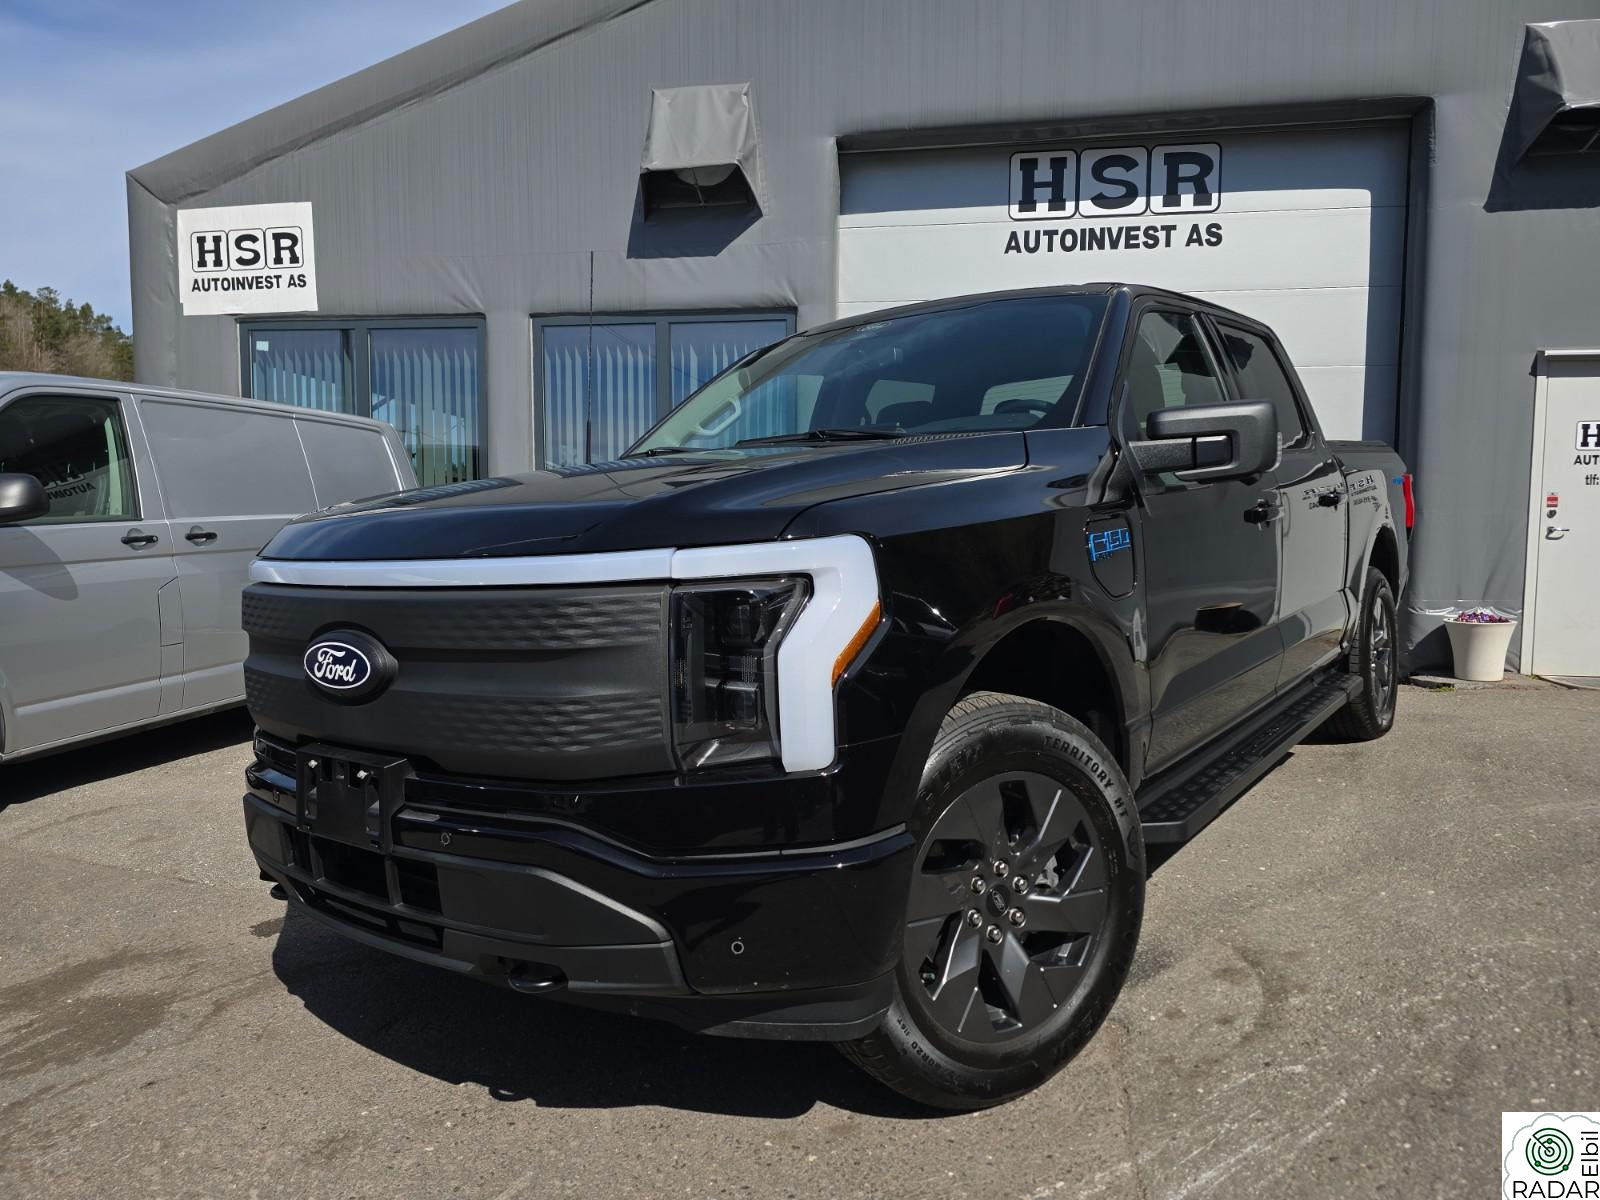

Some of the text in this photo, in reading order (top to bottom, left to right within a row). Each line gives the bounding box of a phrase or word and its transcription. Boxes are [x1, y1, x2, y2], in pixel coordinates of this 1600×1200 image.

[1018, 151, 1214, 213] HSR
[196, 232, 300, 268] HSR
[1004, 222, 1223, 254] AUTOINVEST AS
[192, 273, 307, 292] AUTOINVEST AS
[314, 647, 357, 682] Ford
[1043, 735, 1129, 817] TERRITORY HT
